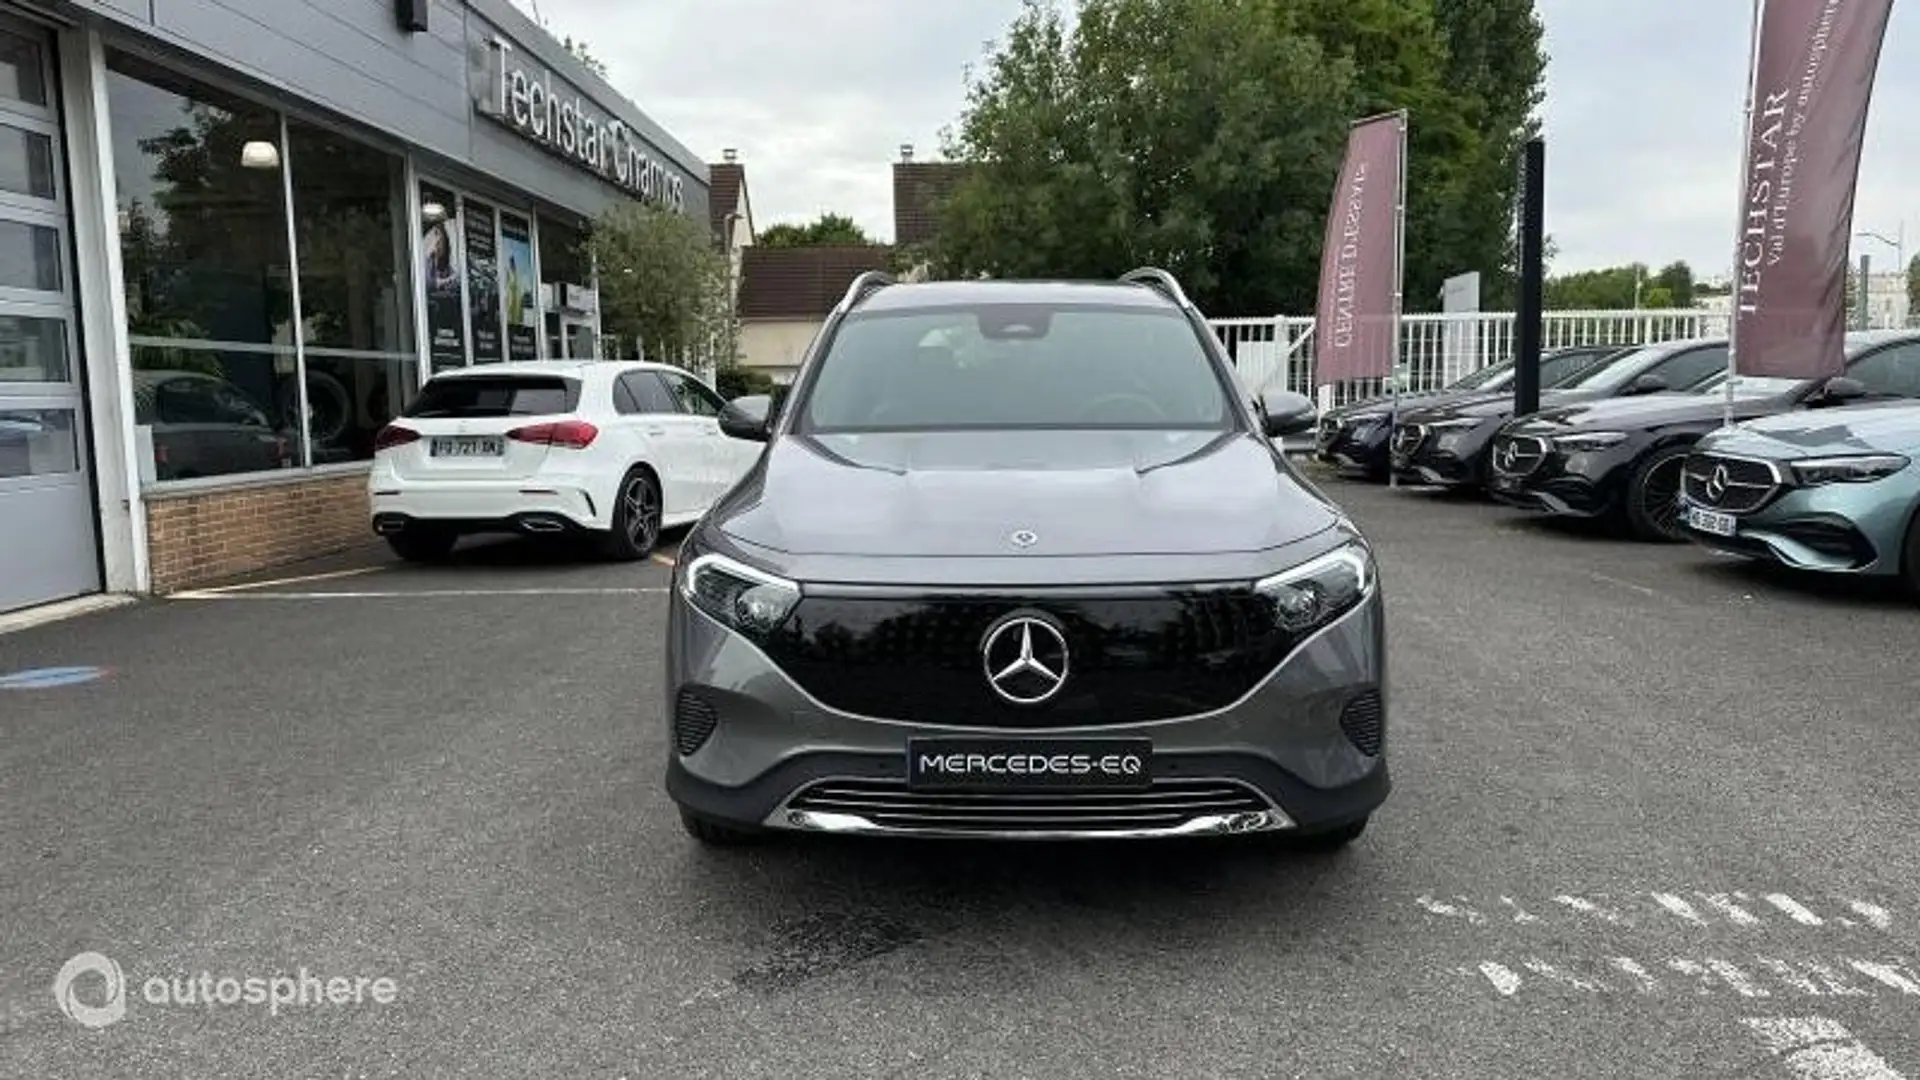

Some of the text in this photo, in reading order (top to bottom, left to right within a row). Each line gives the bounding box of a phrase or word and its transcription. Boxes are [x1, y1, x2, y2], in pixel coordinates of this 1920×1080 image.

[493, 34, 608, 173] Techstar
[1785, 112, 1806, 138] by
[1738, 86, 1790, 320] TECHSTAR
[1769, 138, 1799, 230] d'Europe
[1767, 233, 1786, 266] Val
